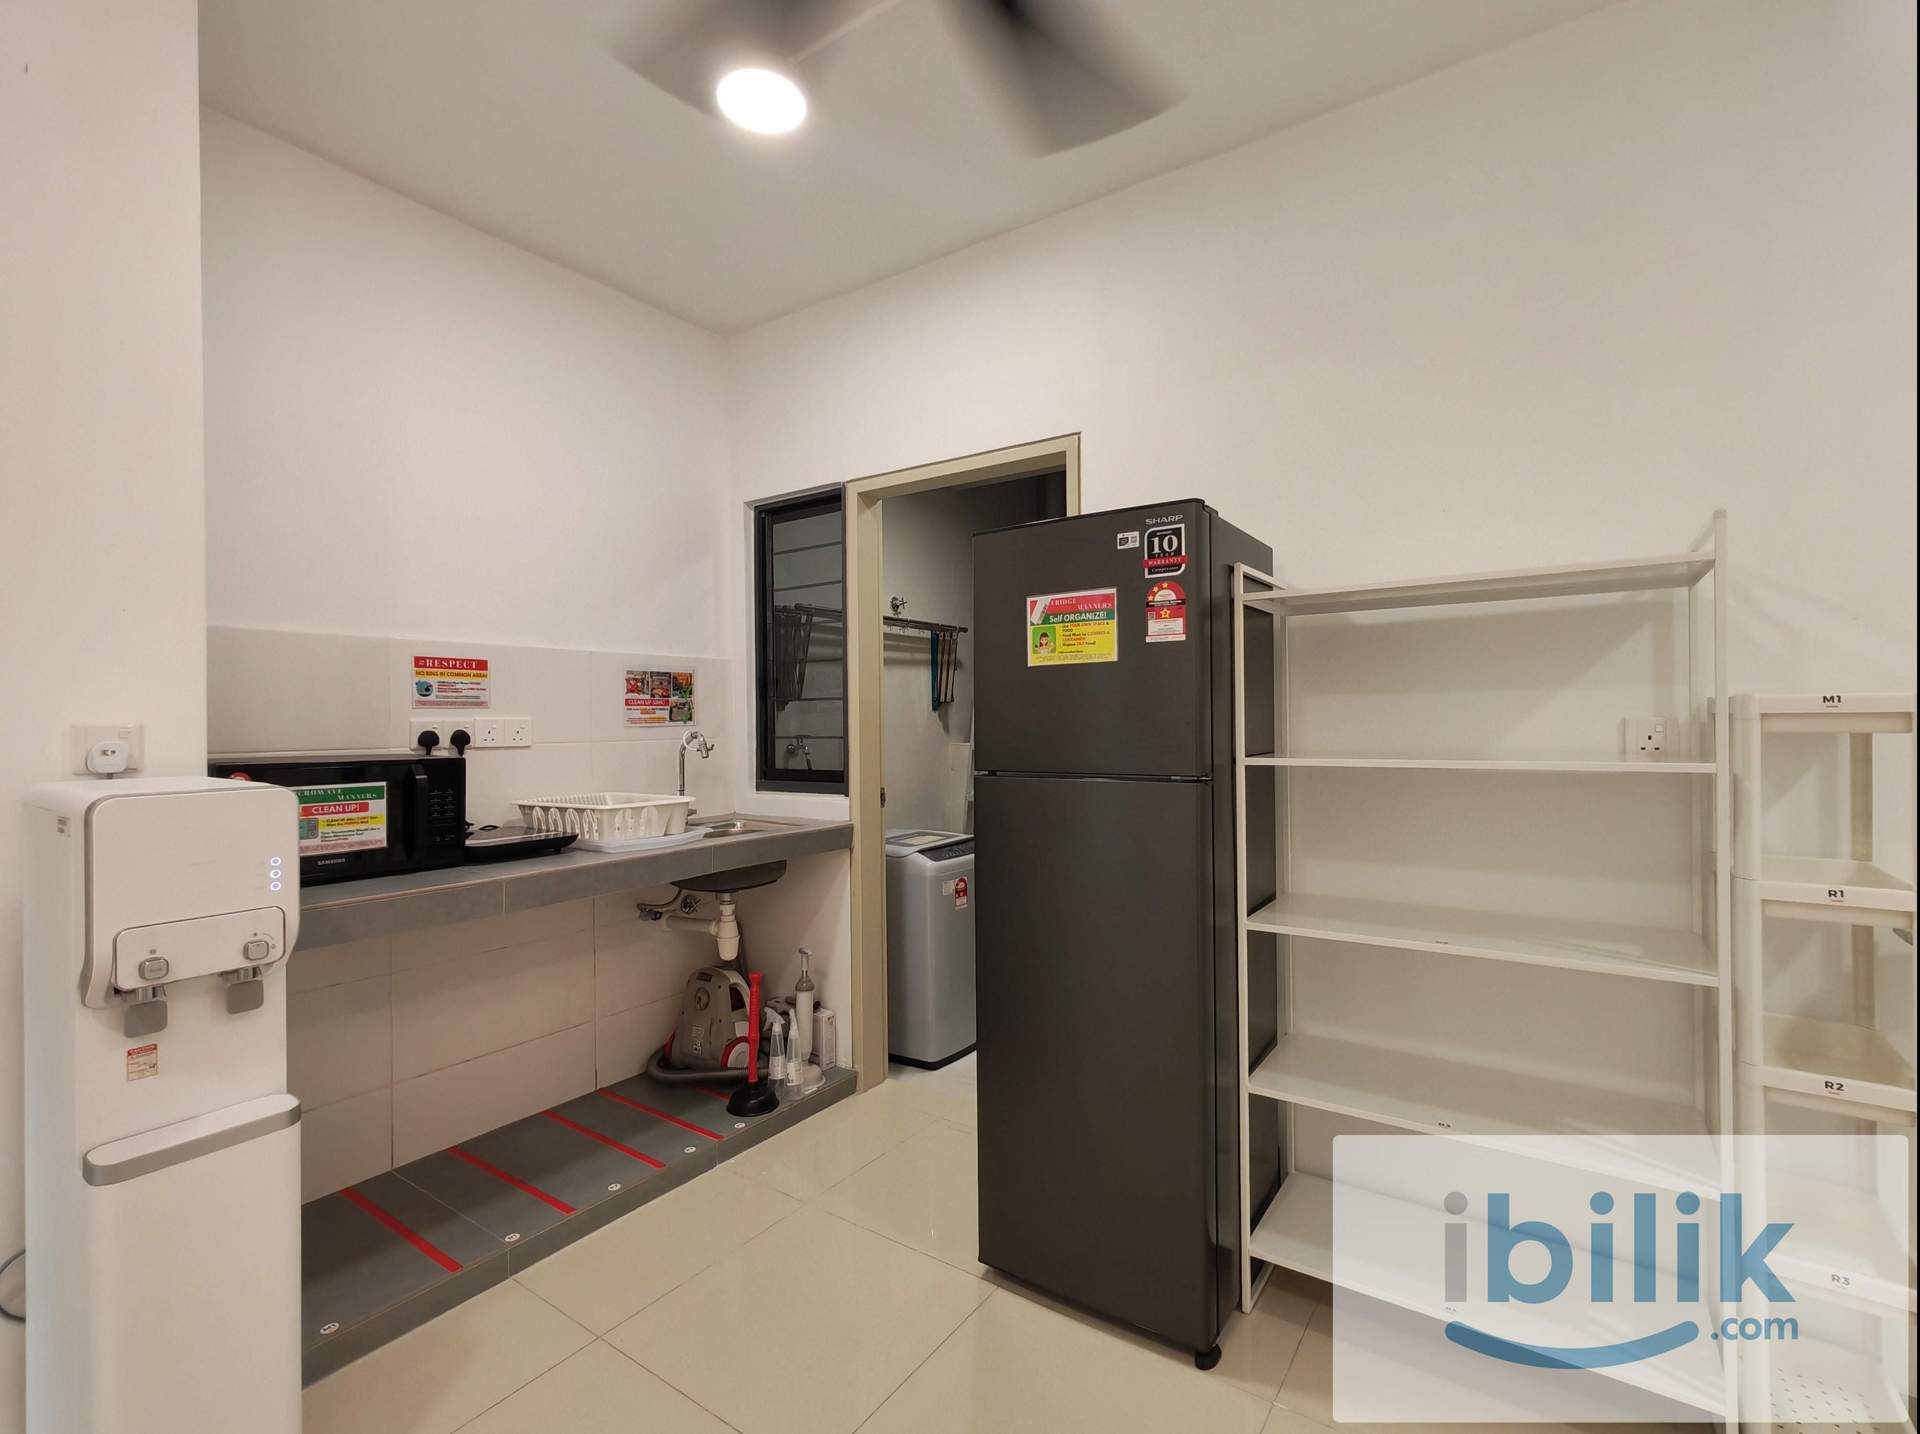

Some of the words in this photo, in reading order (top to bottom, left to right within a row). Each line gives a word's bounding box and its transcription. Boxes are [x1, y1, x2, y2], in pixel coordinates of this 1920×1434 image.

[1145, 514, 1183, 525] SHARP
[1152, 534, 1178, 554] 10
[1148, 558, 1181, 566] WARRANTY
[1050, 598, 1076, 606] FRIDGE
[1049, 615, 1063, 623] Self
[1064, 611, 1107, 622] ORGANIZE!
[1822, 695, 1842, 704] M1
[312, 806, 342, 814] CLEAN
[344, 804, 360, 812] UP!
[1828, 889, 1844, 898] R1
[1824, 1080, 1845, 1092] R2
[1831, 1274, 1851, 1286] R3
